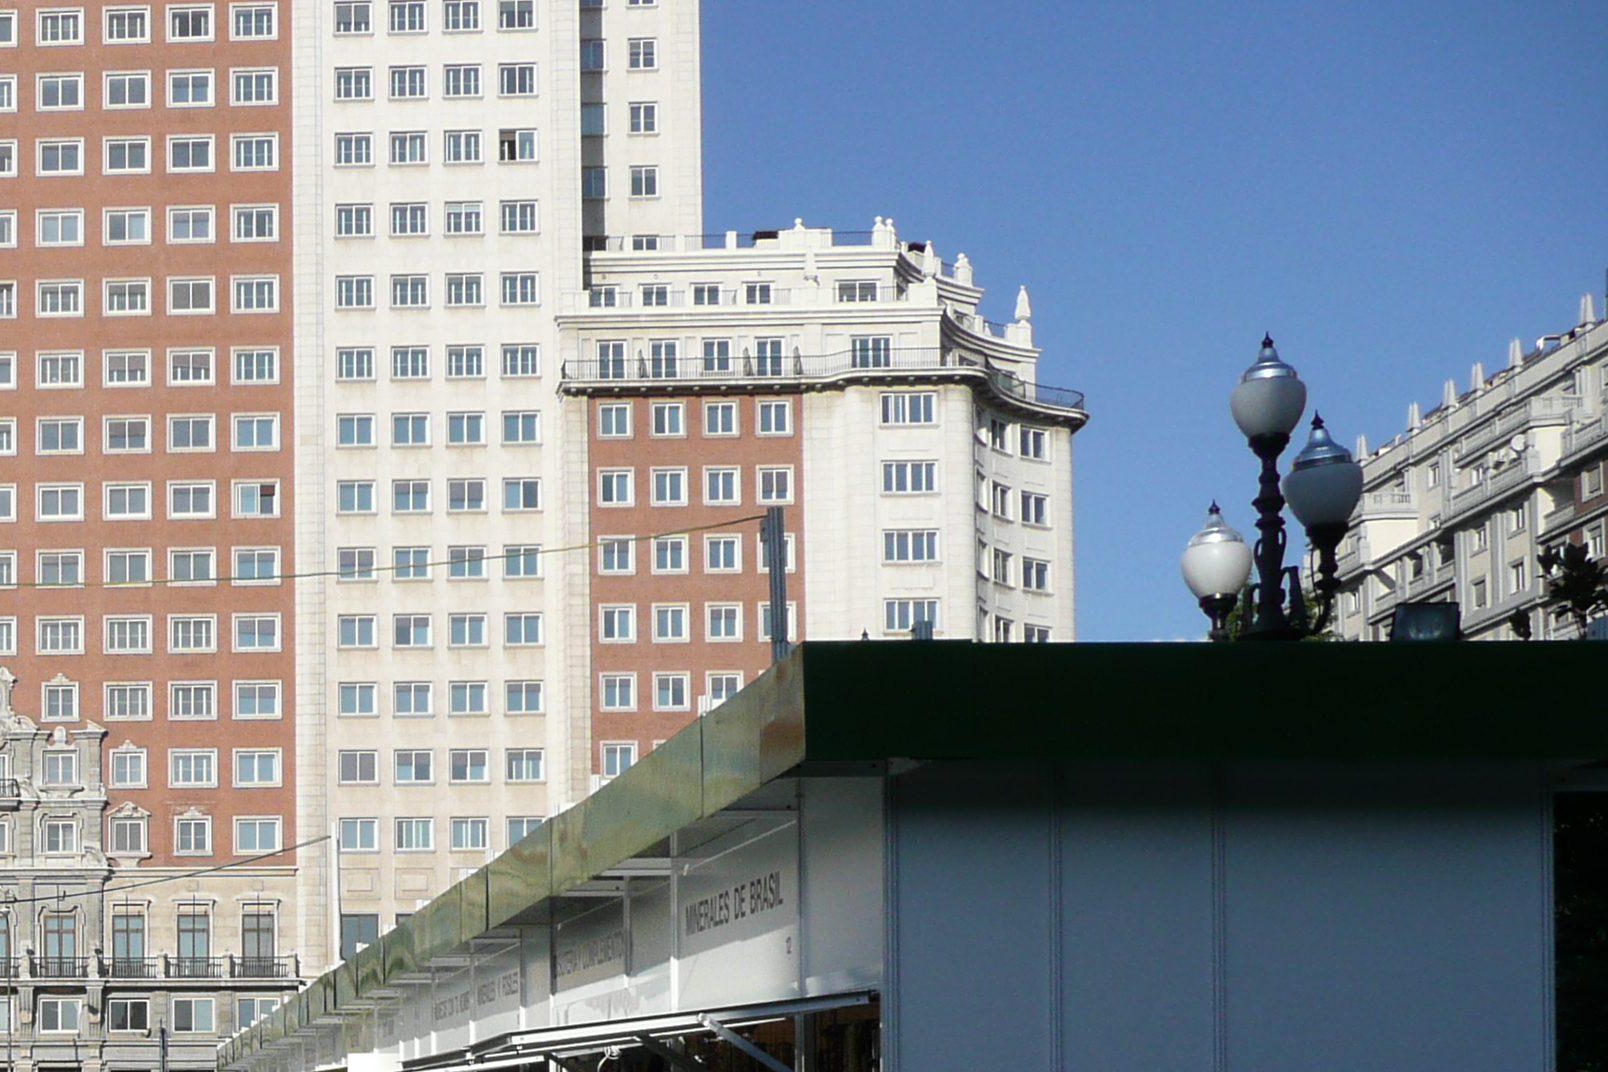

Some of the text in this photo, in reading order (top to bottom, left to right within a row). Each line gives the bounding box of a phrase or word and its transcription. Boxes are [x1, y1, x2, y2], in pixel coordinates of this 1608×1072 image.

[685, 869, 784, 937] MINERALES DE BRASIL
